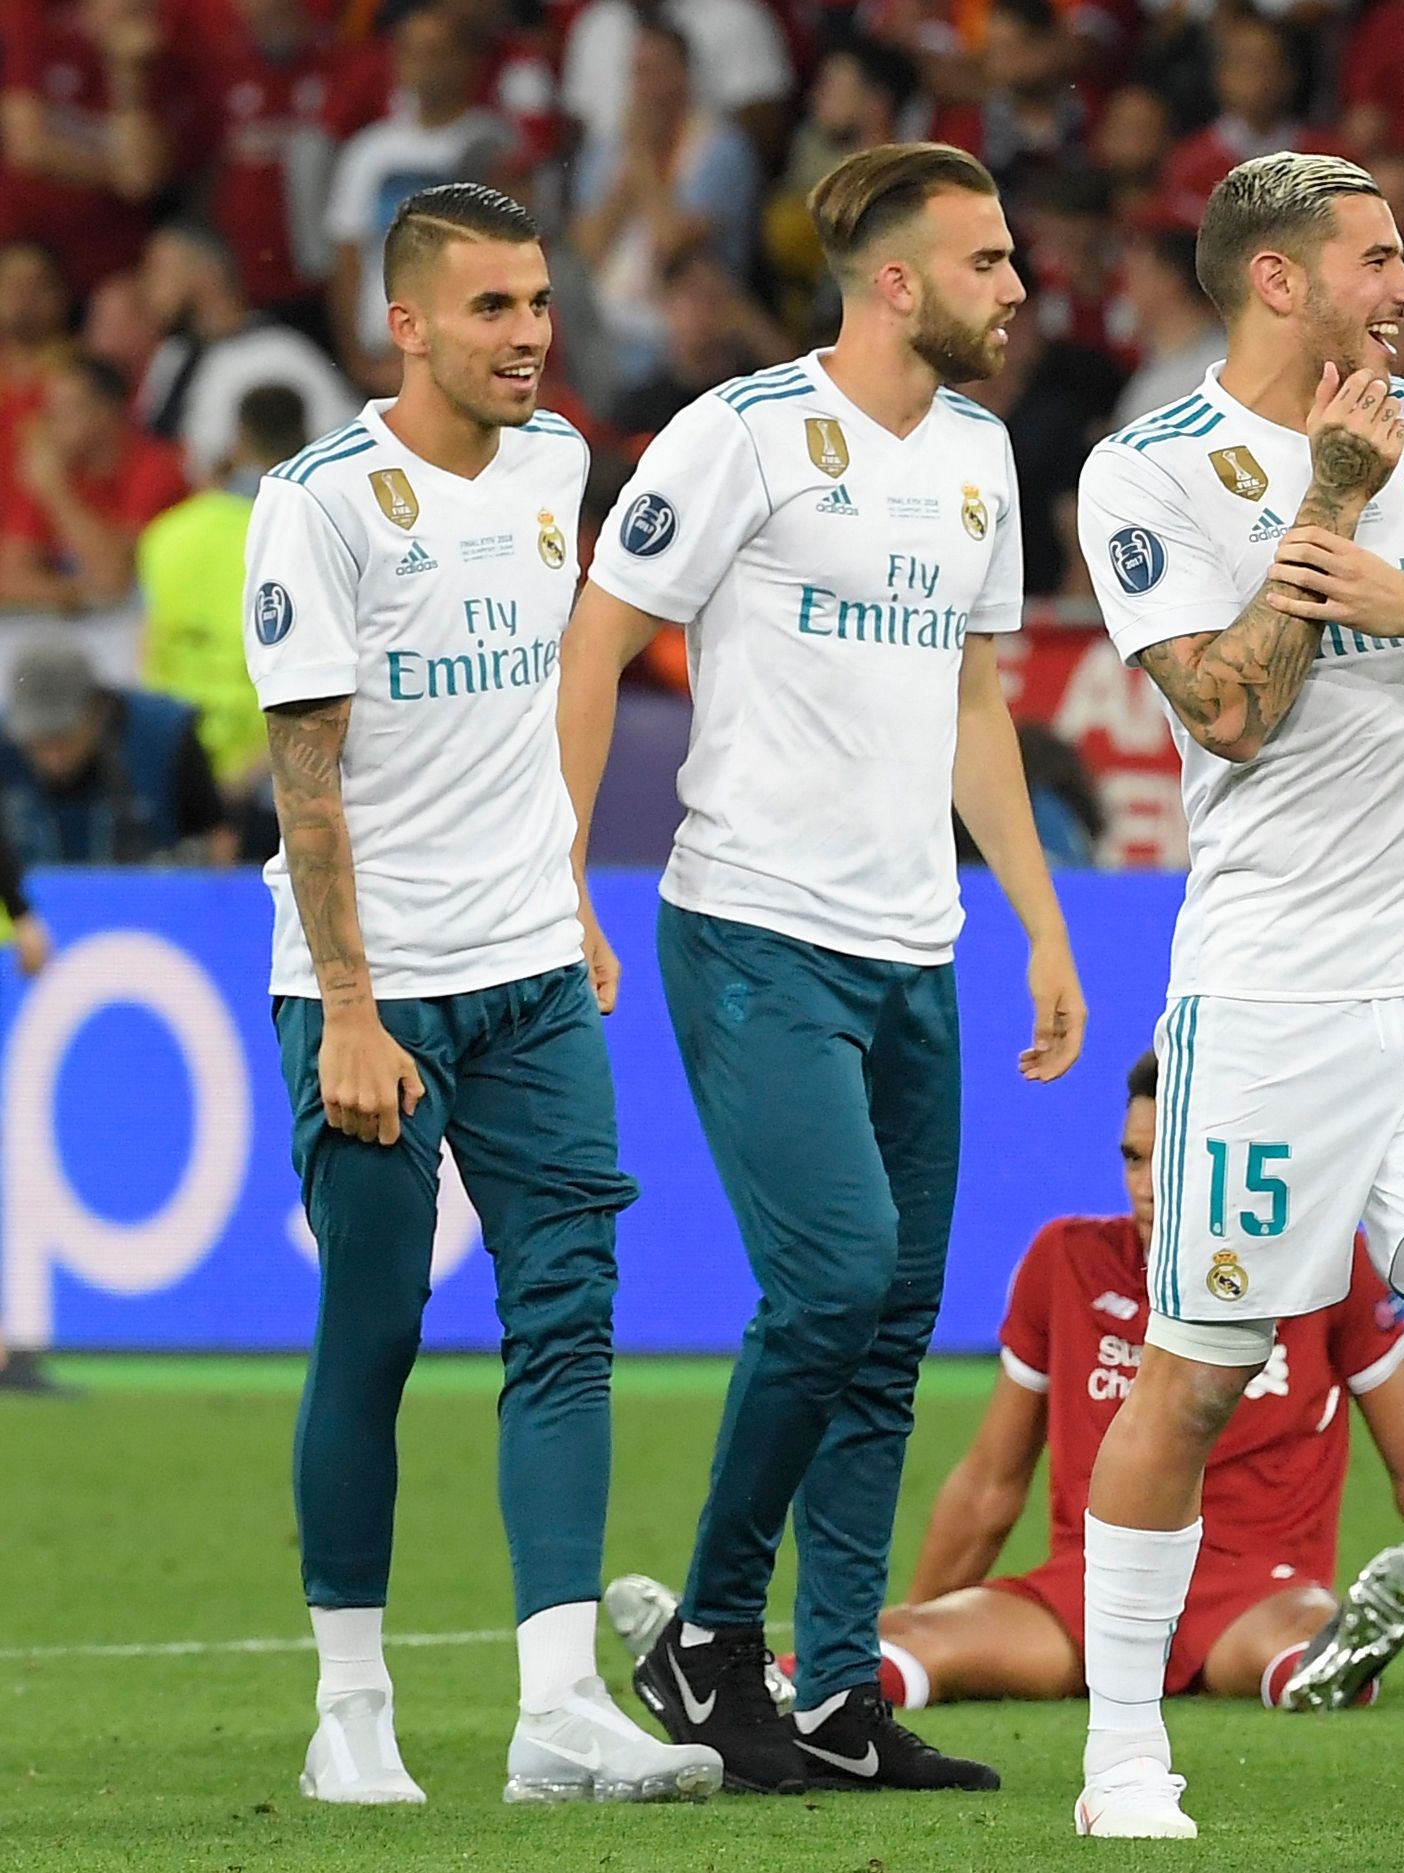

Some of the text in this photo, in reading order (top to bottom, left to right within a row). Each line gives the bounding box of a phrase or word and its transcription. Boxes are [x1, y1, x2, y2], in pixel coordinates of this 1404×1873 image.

[815, 501, 859, 517] adidas
[1248, 525, 1290, 543] adida
[395, 558, 439, 577] adidas
[886, 553, 939, 599] Fly
[462, 597, 517, 637] Fly
[798, 585, 970, 650] Emirate
[385, 637, 559, 701] Emirate
[1207, 1137, 1291, 1237] 15
